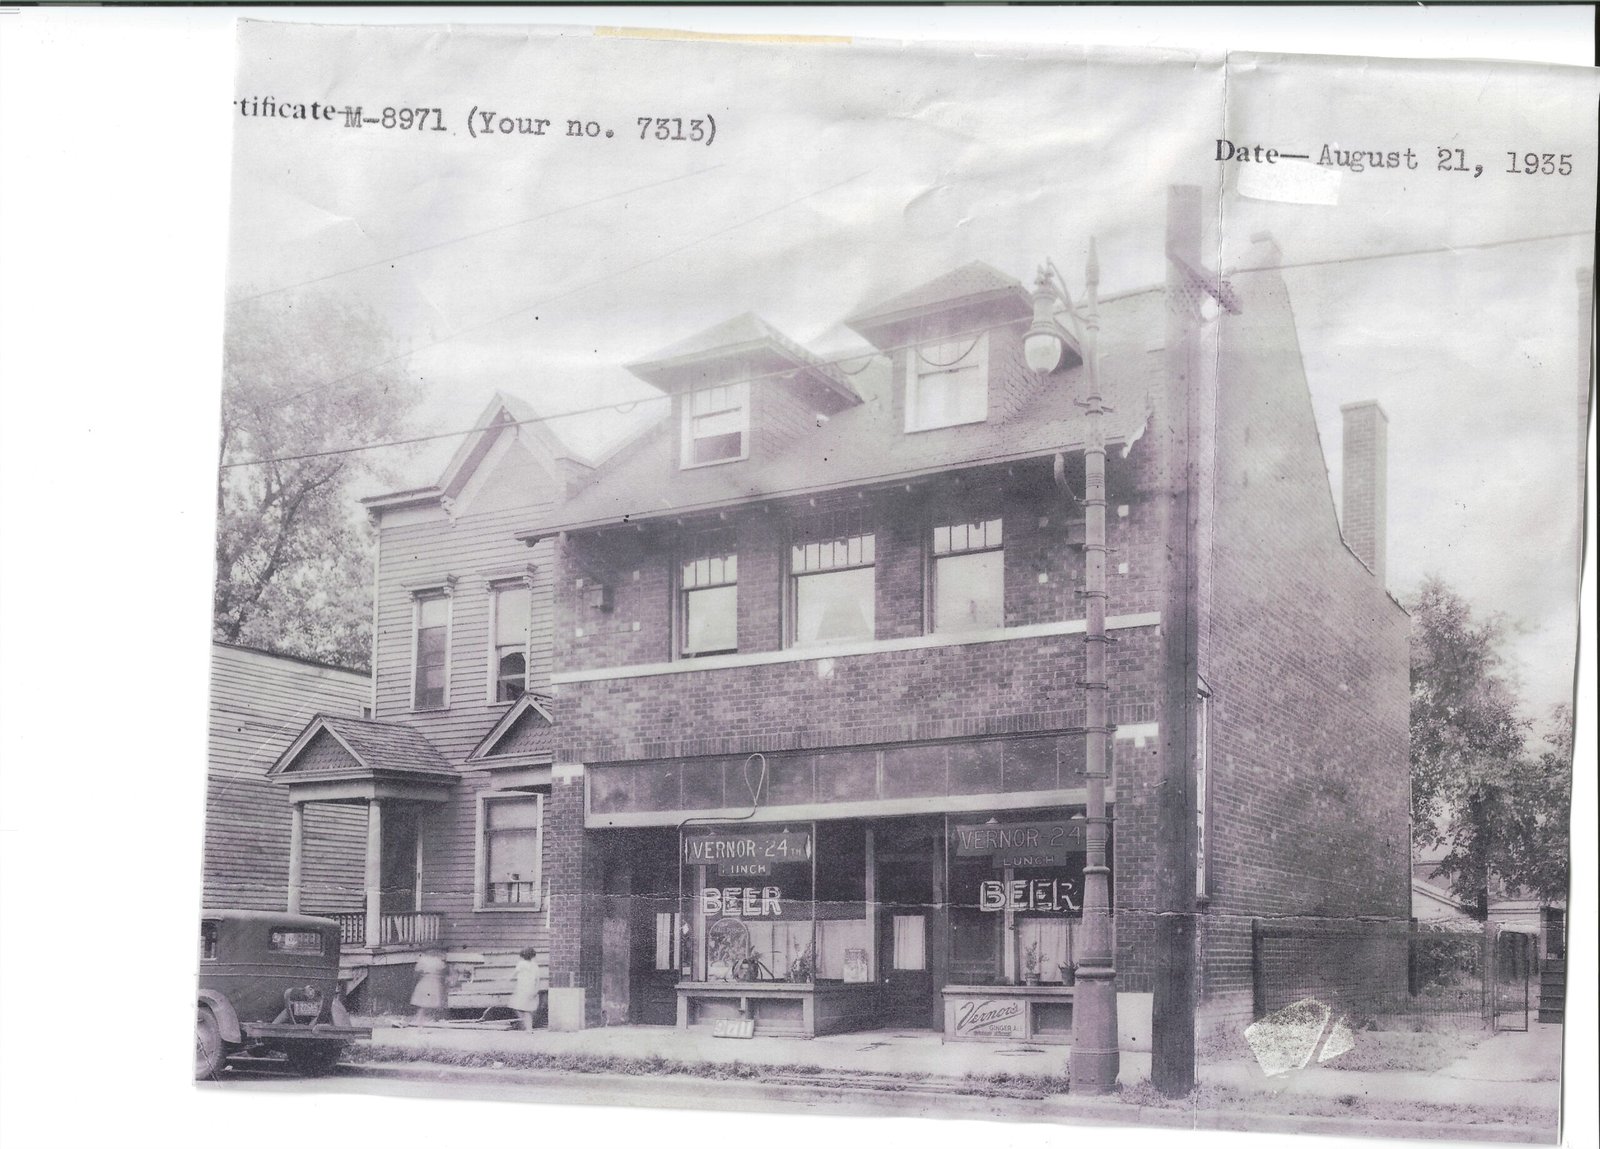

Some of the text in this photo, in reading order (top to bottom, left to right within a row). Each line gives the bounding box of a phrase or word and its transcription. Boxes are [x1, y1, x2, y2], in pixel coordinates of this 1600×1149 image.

[468, 105, 550, 138] (Your
[566, 119, 615, 138] no.
[637, 114, 717, 146] 7313)
[1316, 144, 1418, 172] August
[1437, 147, 1484, 178] 21,
[1506, 151, 1573, 176] 1935
[1003, 855, 1055, 866] LUNCH
[701, 886, 782, 916] BEER
[980, 880, 1081, 912] BEER
